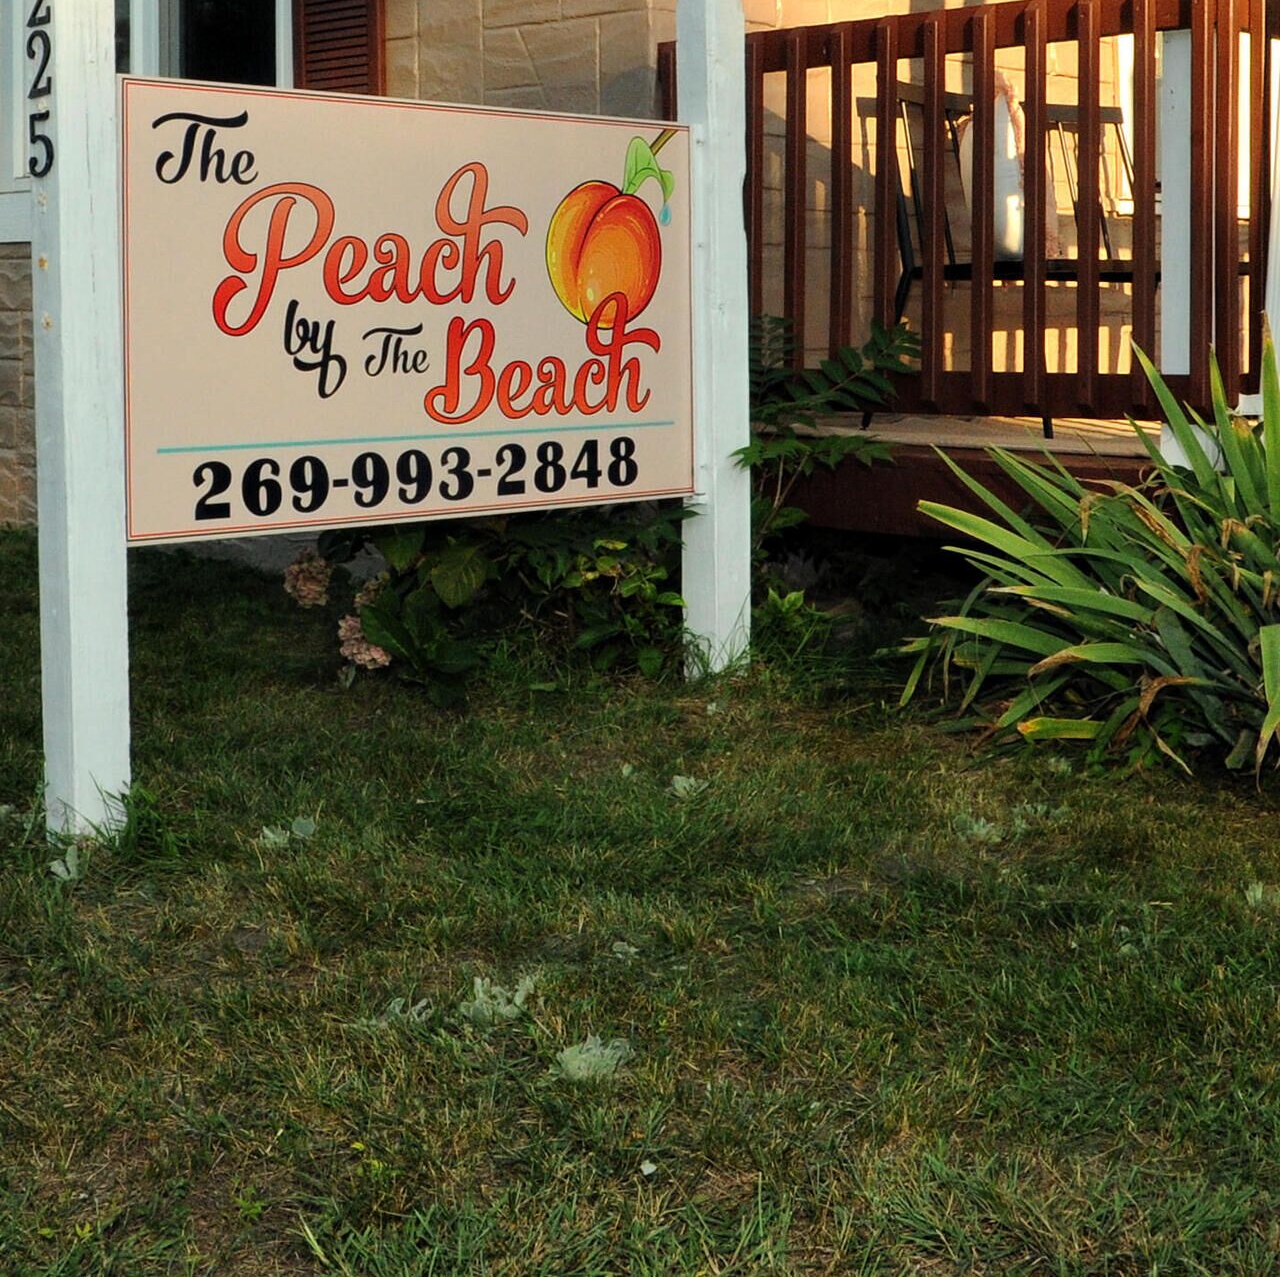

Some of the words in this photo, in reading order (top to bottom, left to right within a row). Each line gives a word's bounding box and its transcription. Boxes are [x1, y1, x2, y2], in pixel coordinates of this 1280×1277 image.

[152, 110, 259, 184] The
[212, 161, 528, 337] Peach
[284, 299, 347, 398] by
[362, 322, 430, 376] The
[423, 291, 661, 424] Beach
[192, 436, 639, 521] 269-993-2848
